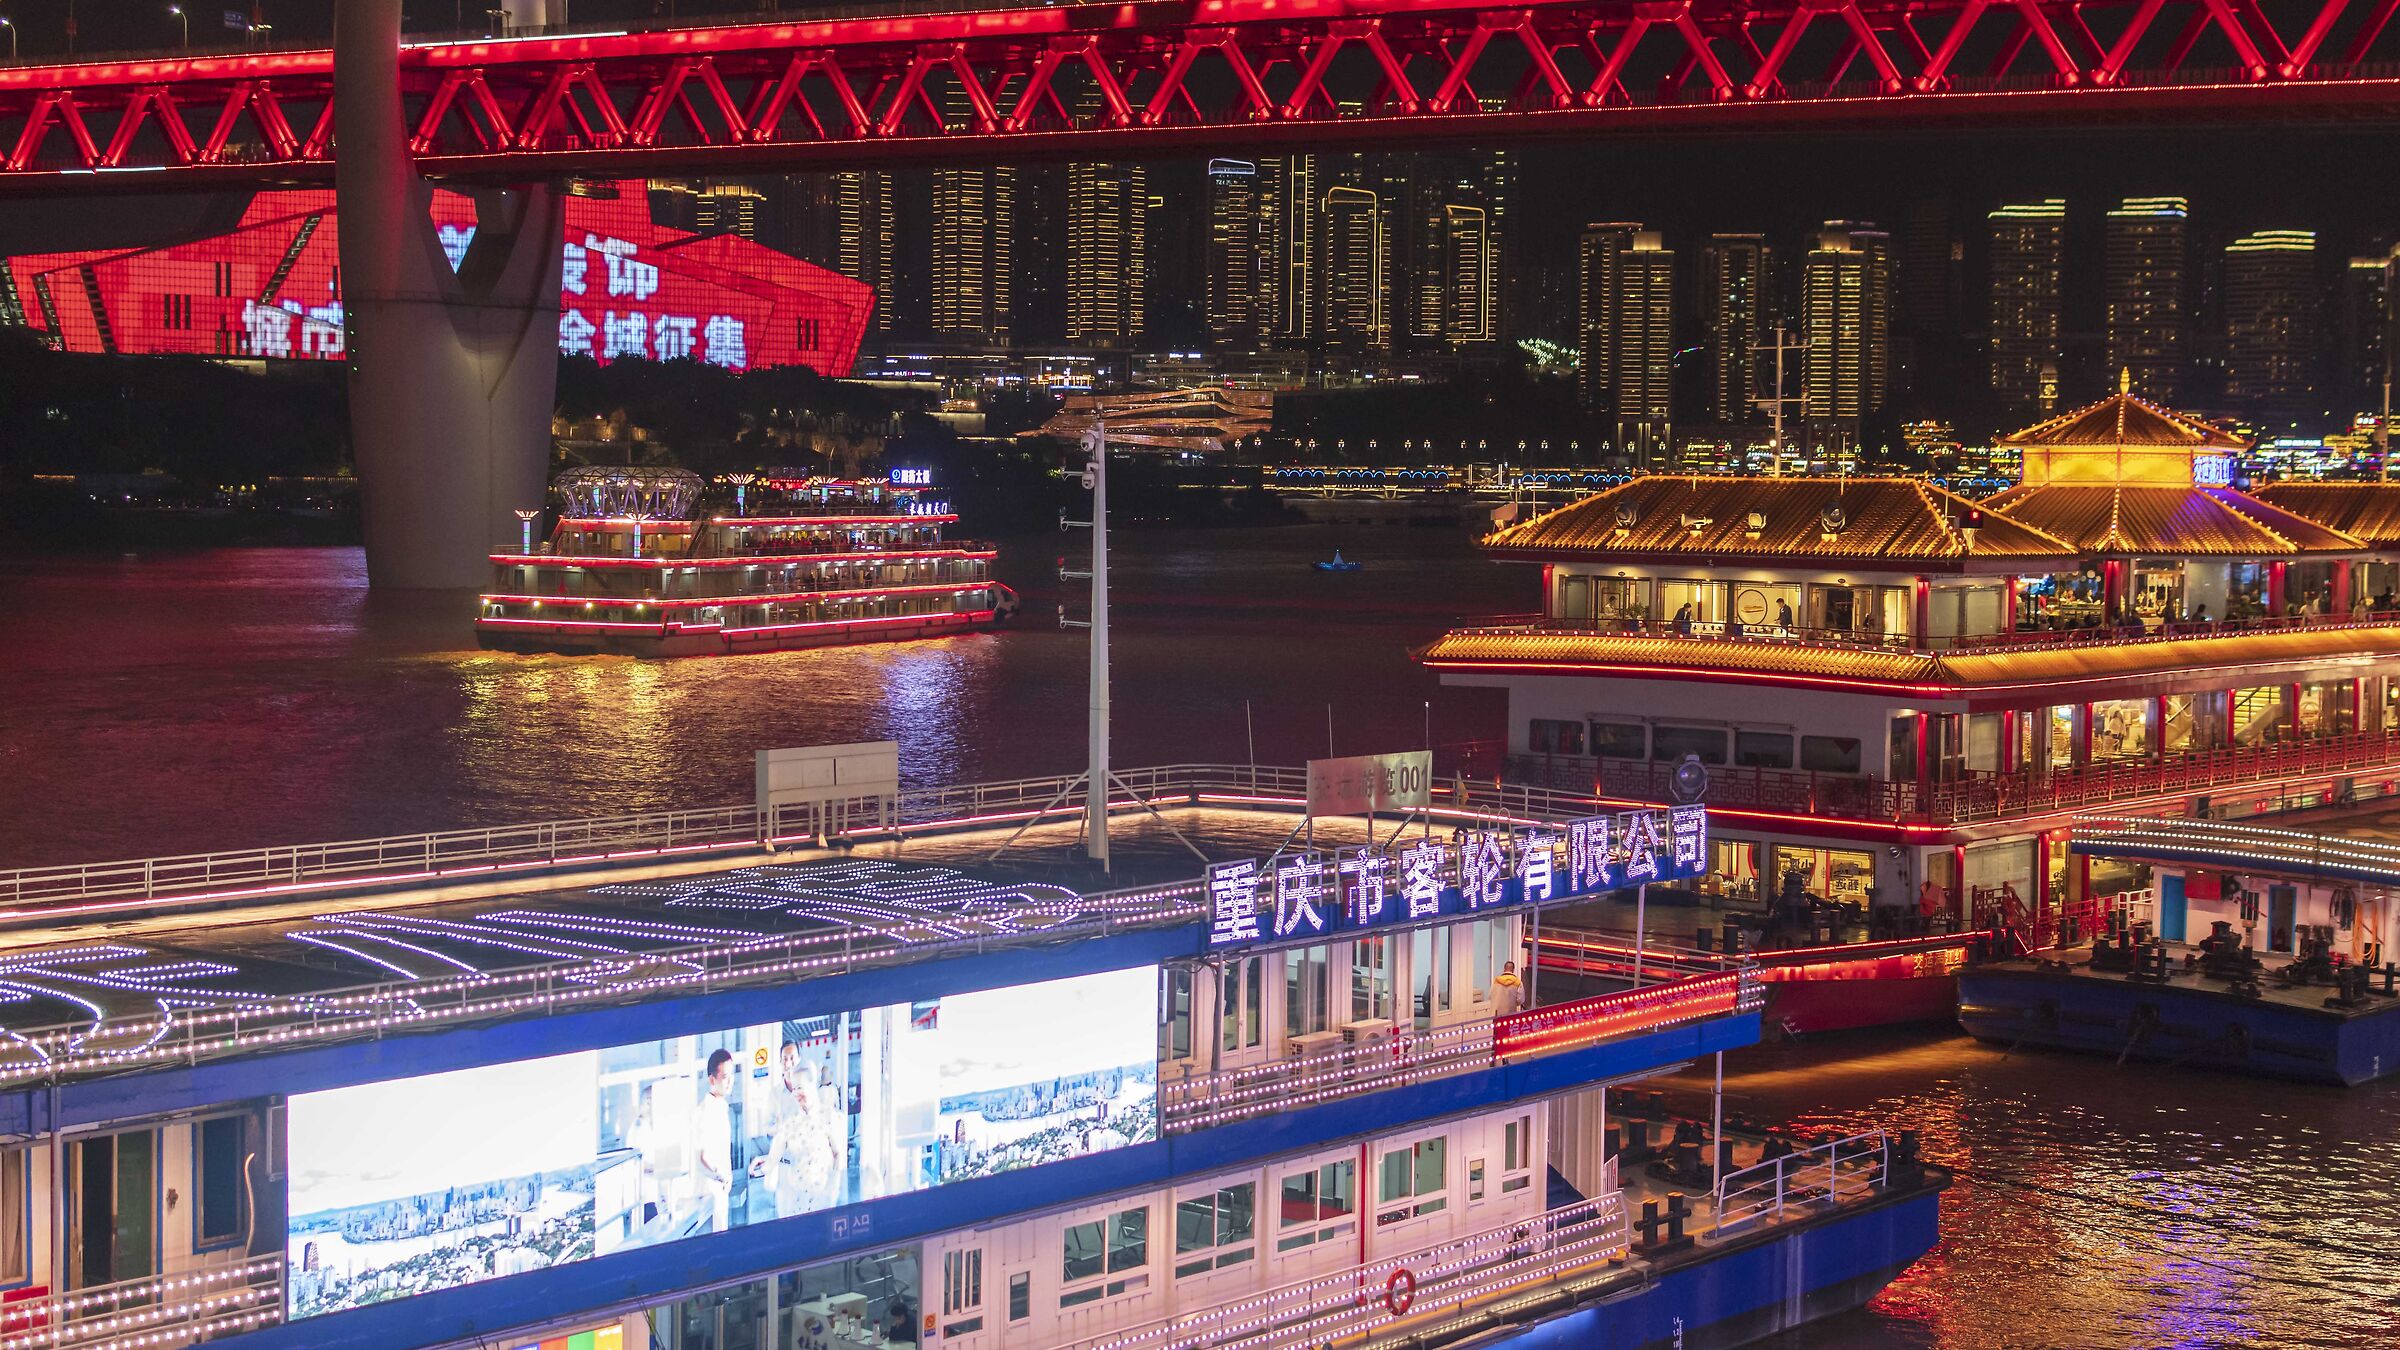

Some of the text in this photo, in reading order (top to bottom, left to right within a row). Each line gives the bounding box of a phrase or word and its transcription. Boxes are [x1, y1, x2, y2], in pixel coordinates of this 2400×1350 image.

[1210, 803, 1706, 944] 重庆市客轮有限公司
[852, 1214, 870, 1228] 入口
